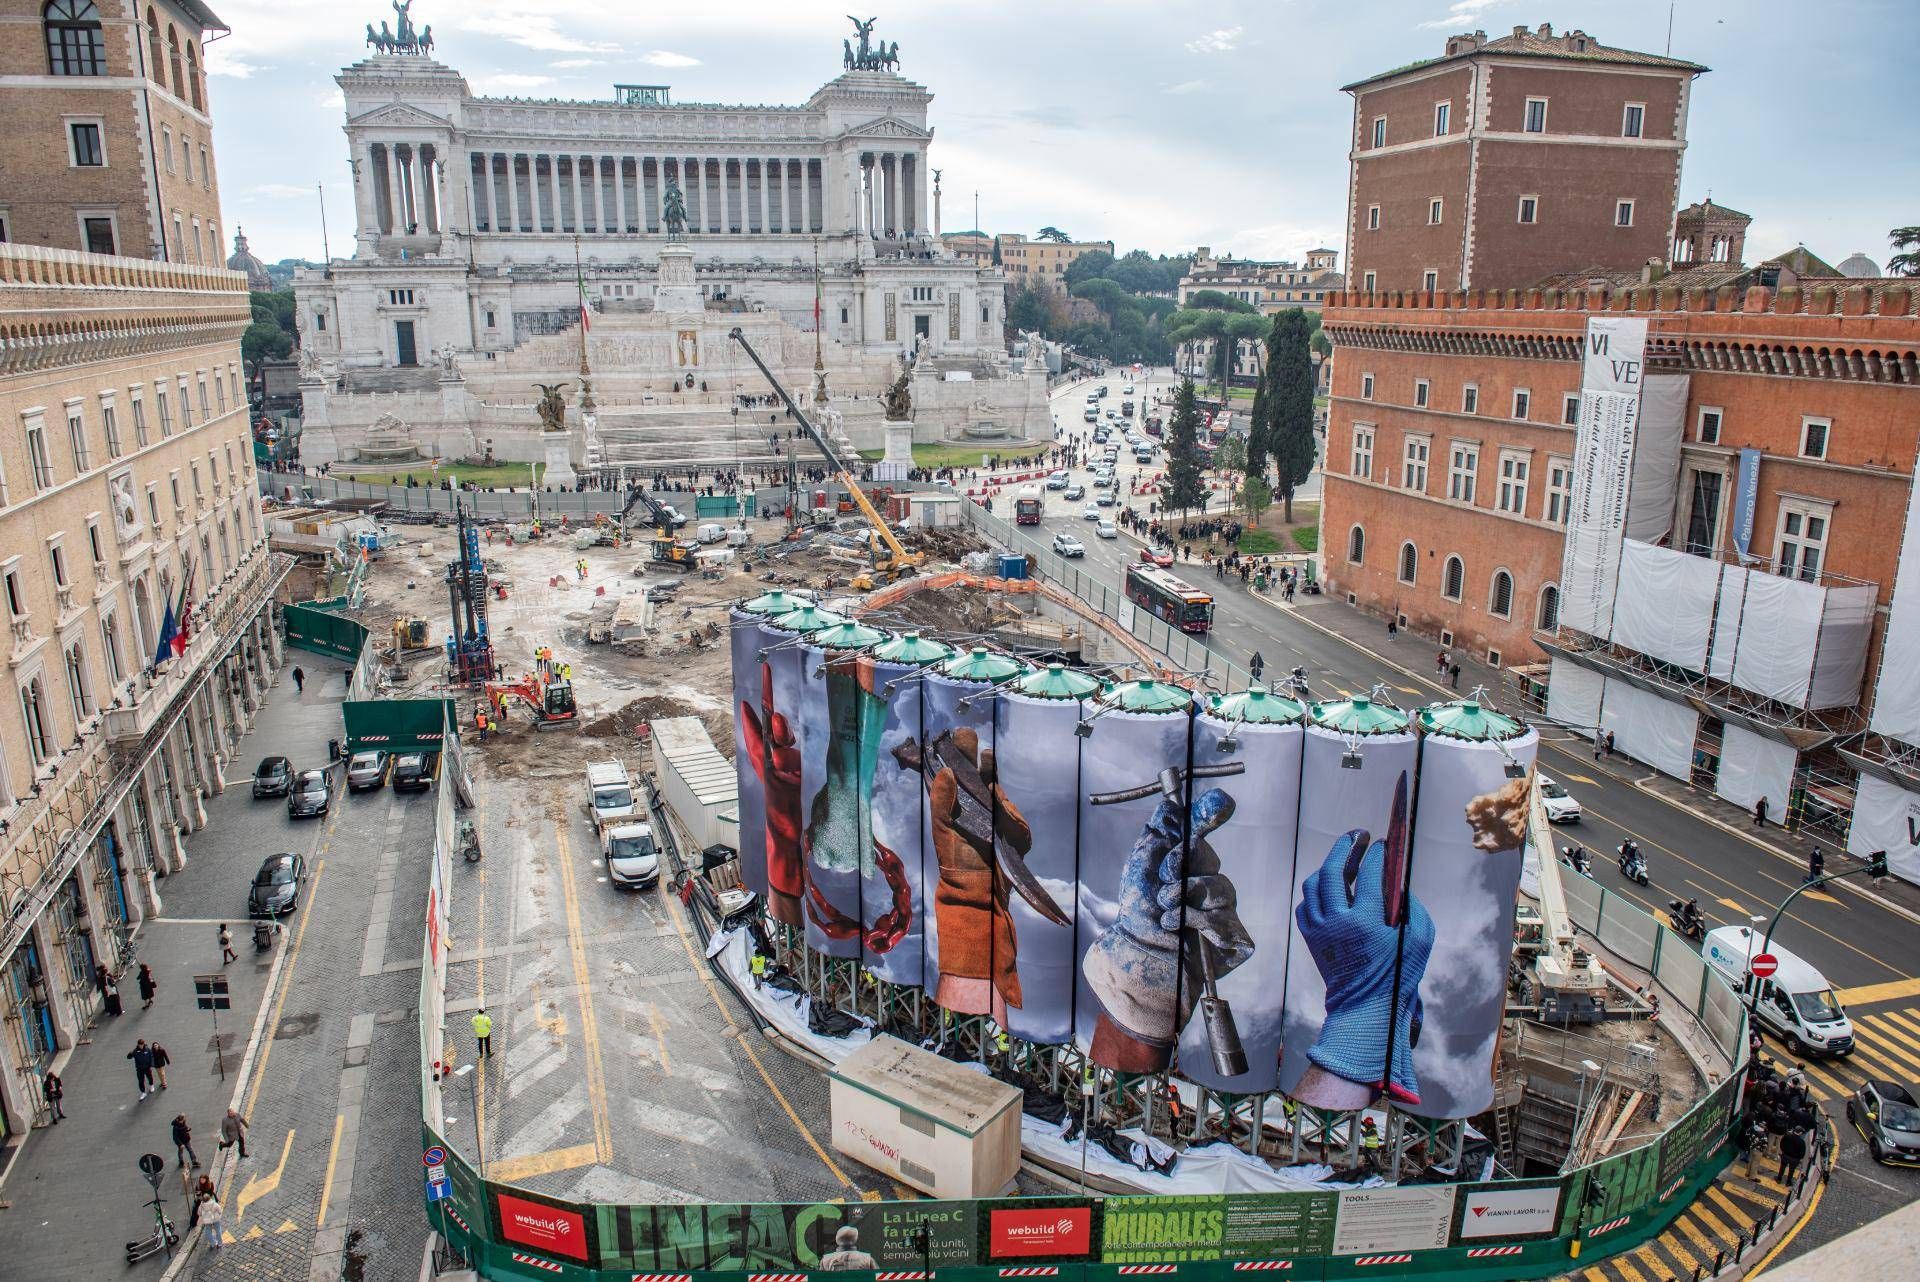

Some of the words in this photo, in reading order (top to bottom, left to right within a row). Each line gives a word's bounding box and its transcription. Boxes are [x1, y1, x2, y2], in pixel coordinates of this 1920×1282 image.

[1591, 333, 1608, 356] VI
[1611, 360, 1640, 384] VE
[1592, 394, 1603, 421] Sala
[1624, 397, 1637, 424] Sala
[1591, 424, 1600, 442] del
[1622, 426, 1632, 444] del
[1580, 445, 1597, 523] Mappamondo
[1746, 455, 1759, 498] Venezia
[1611, 448, 1629, 529] Mappamondo
[1741, 500, 1754, 541] Palazzo
[515, 1213, 554, 1231] webuild
[883, 1211, 901, 1223] La
[908, 1210, 949, 1222] Linea
[952, 1210, 963, 1221] C
[1104, 1210, 1223, 1245] MURALES
[883, 1226, 898, 1238] fa
[1008, 1225, 1055, 1234] webuild
[1435, 1215, 1448, 1245] ROMA
[941, 1239, 967, 1249] uniti,
[943, 1249, 969, 1258] vicini
[1123, 1240, 1186, 1249] contemporanea
[1197, 1239, 1222, 1247] metro
